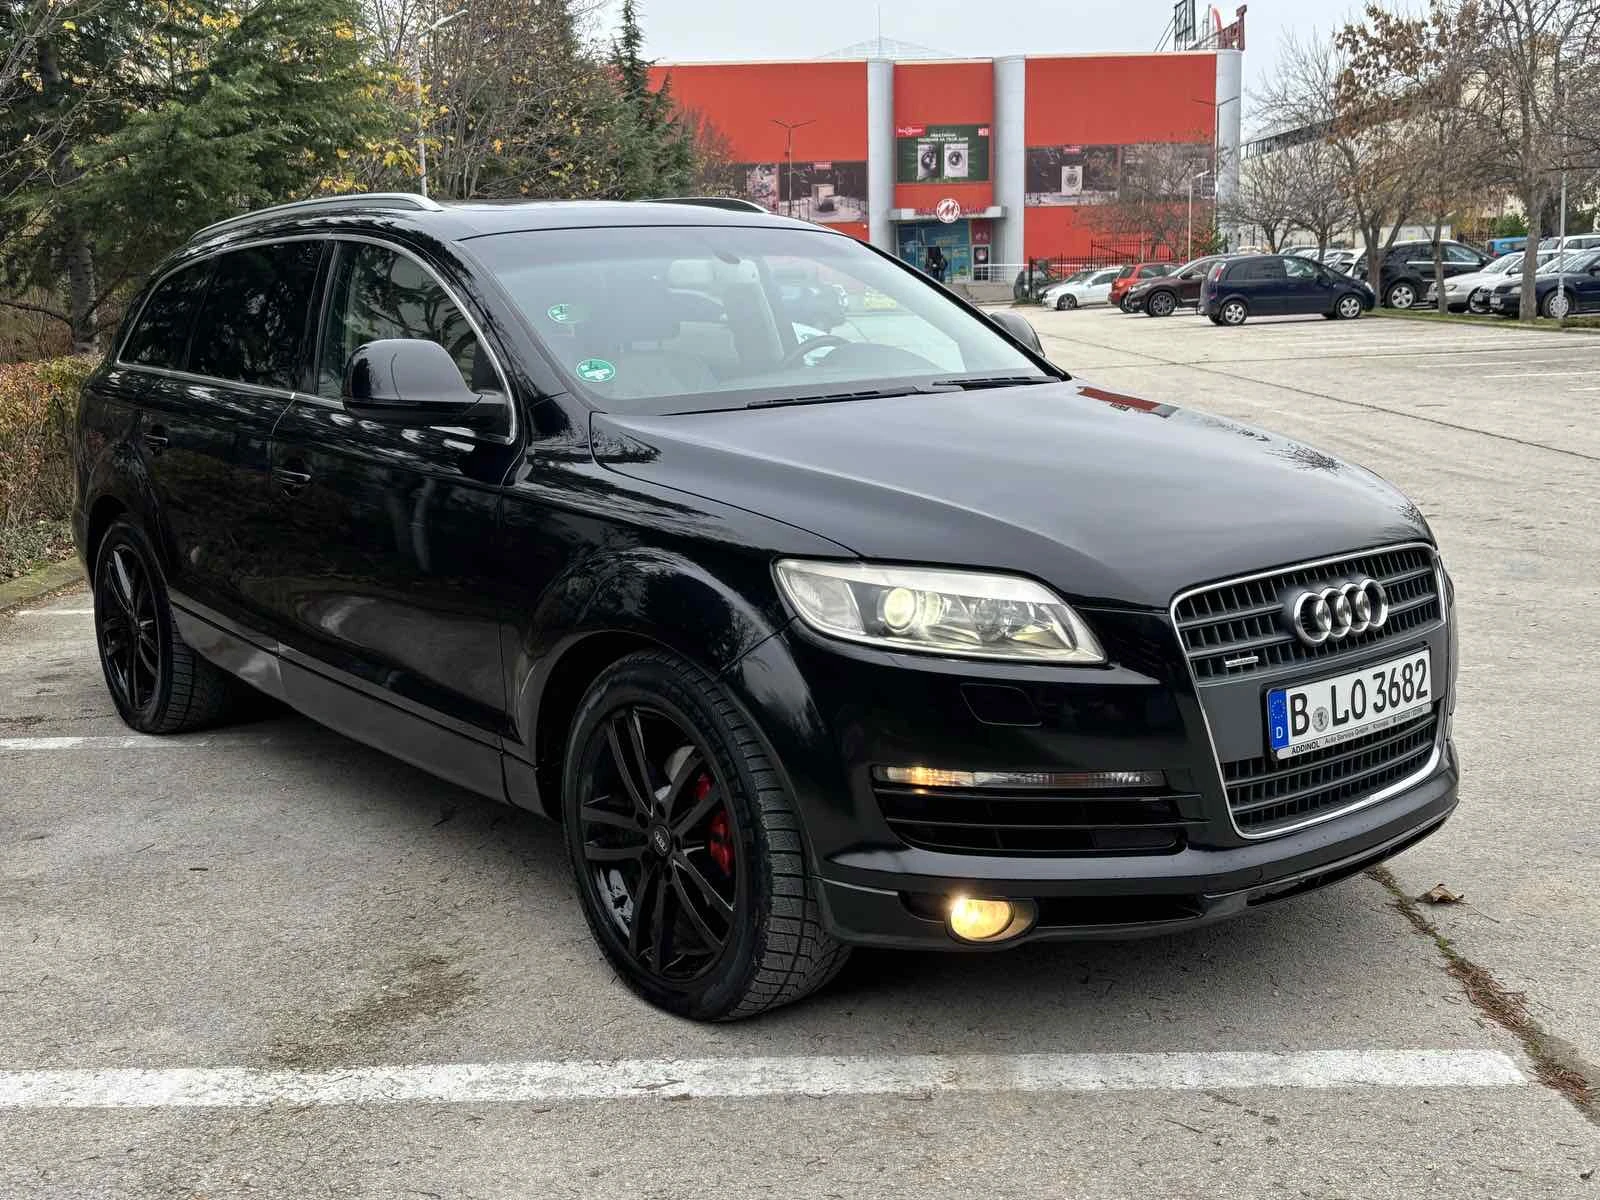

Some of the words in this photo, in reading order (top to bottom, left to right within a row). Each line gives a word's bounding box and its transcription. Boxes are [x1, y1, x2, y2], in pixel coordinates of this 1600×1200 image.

[1290, 692, 1310, 737] B
[1331, 678, 1367, 726] LO
[1372, 658, 1428, 713] 3682
[1275, 726, 1283, 739] D
[1291, 740, 1321, 755] ADDINOL
